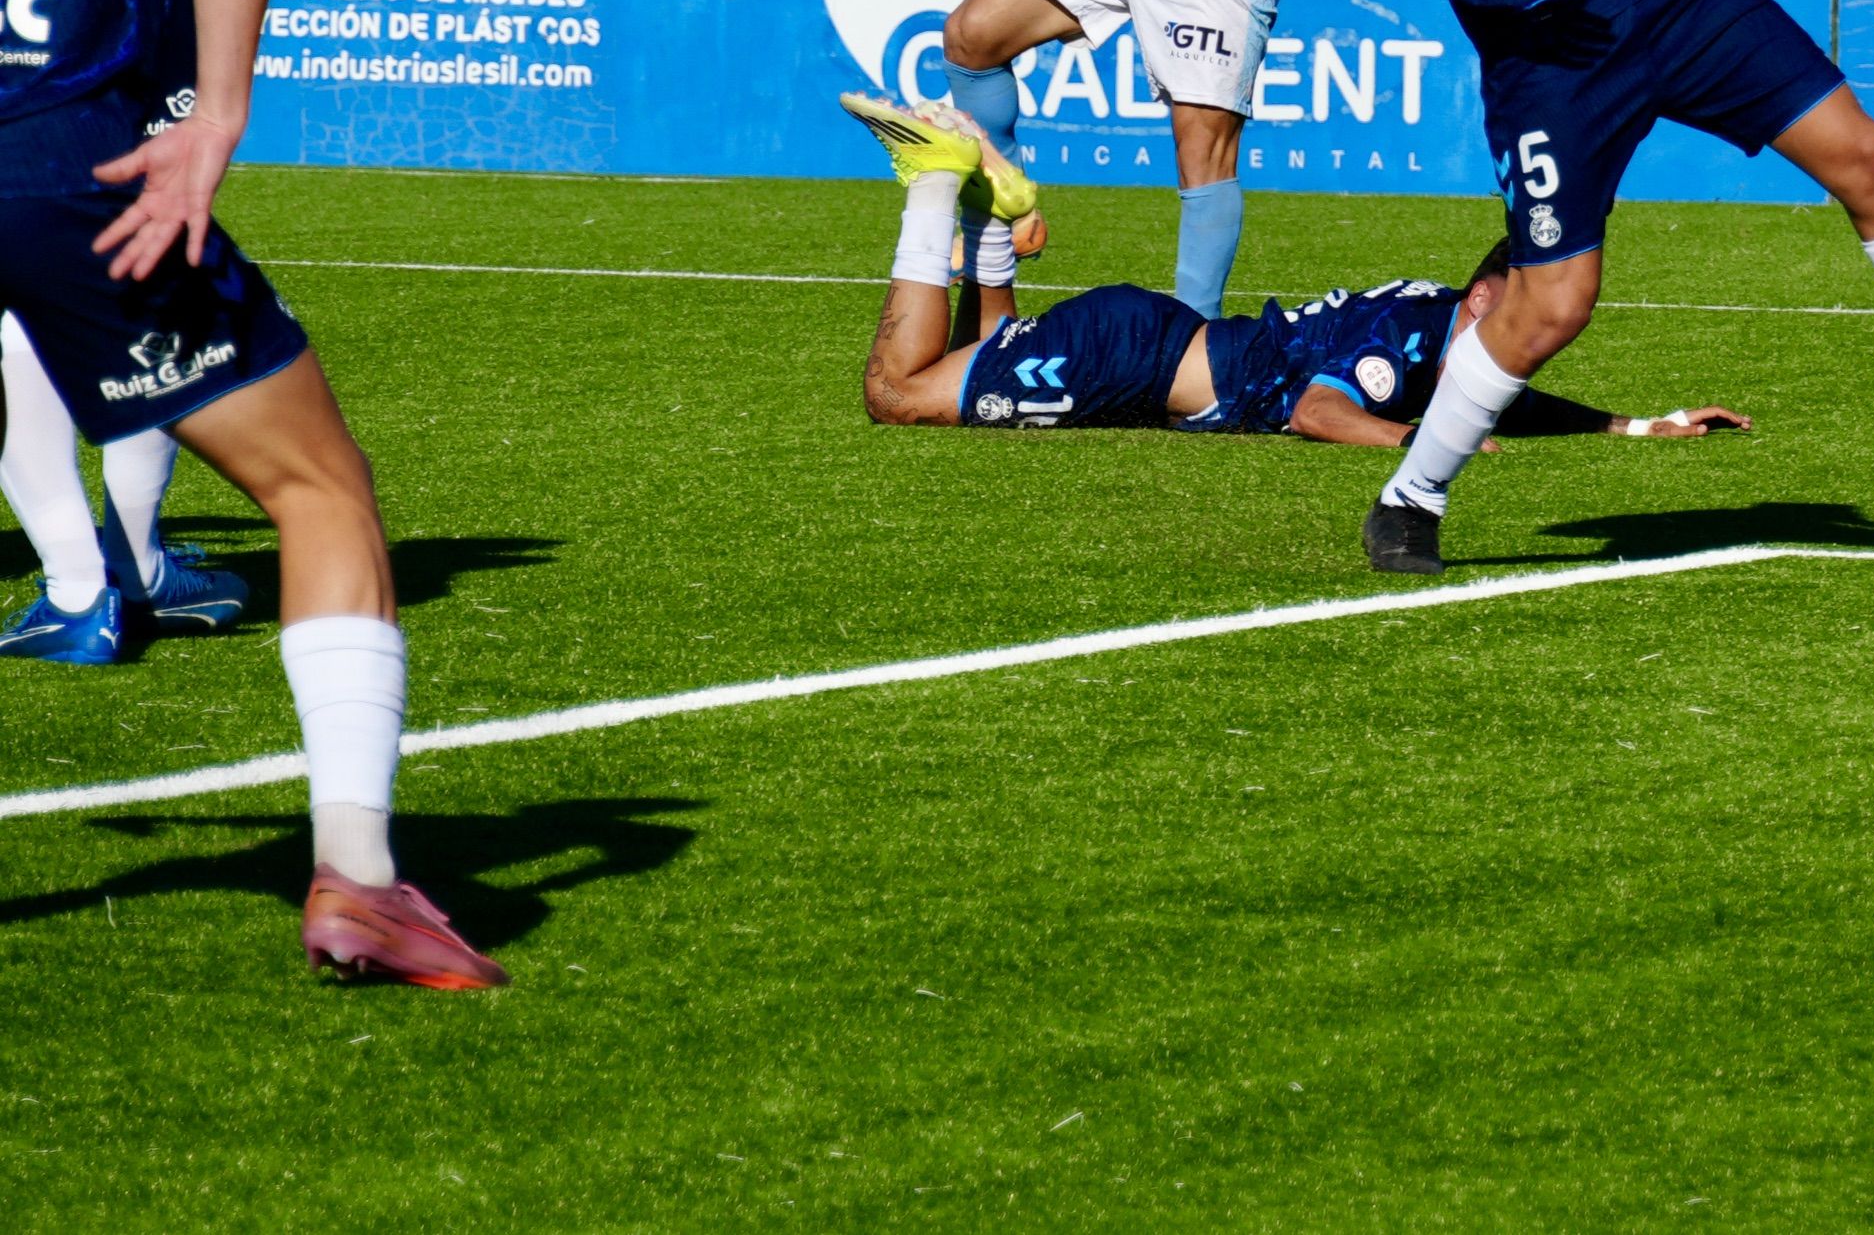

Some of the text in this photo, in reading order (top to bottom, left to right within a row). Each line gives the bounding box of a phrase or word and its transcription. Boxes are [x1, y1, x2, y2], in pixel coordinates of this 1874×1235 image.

[260, 3, 601, 47] ECCIÓN DE PLÁSTCOS
[1173, 24, 1233, 57] GTL
[252, 47, 593, 88] w.industriaslesil.com
[1020, 144, 1424, 172] NICA ENTAL
[1517, 130, 1561, 201] 5
[99, 374, 160, 402] Ruiz
